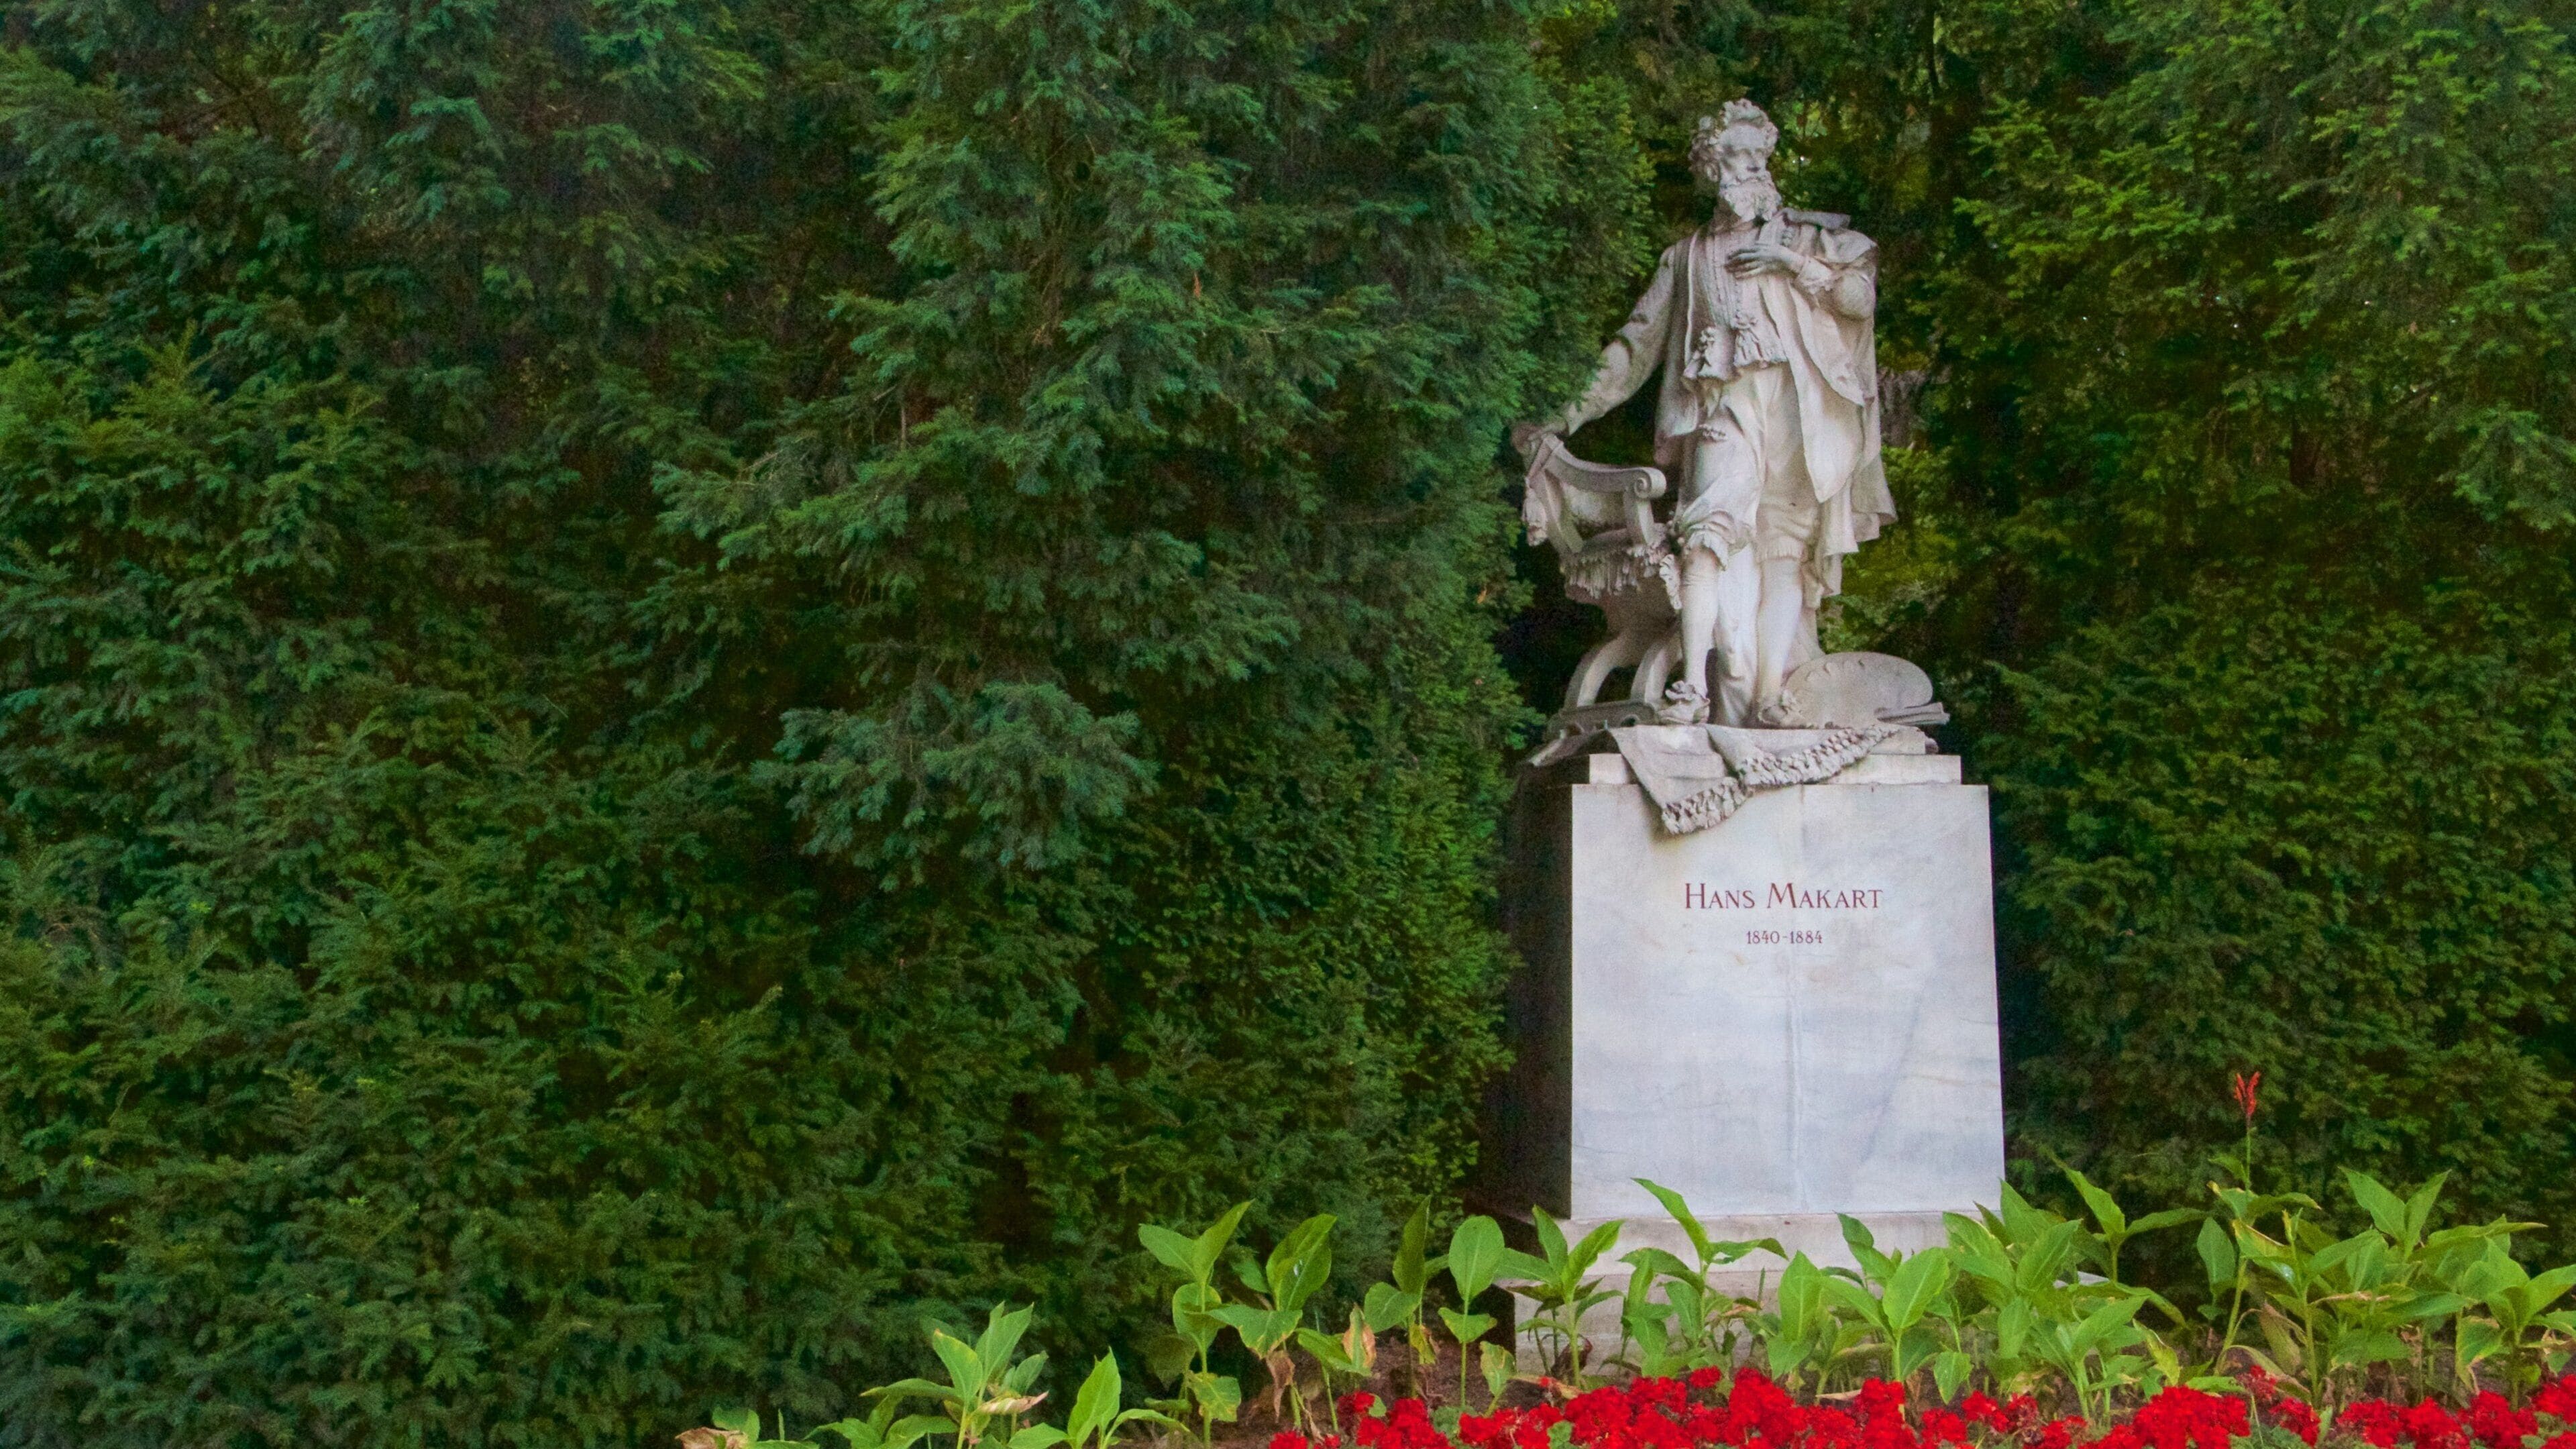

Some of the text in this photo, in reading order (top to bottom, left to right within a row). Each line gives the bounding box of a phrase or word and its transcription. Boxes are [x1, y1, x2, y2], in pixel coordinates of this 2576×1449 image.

[1684, 882, 1883, 909] HANS MAKART
[1746, 930, 1823, 945] 1840-1884
